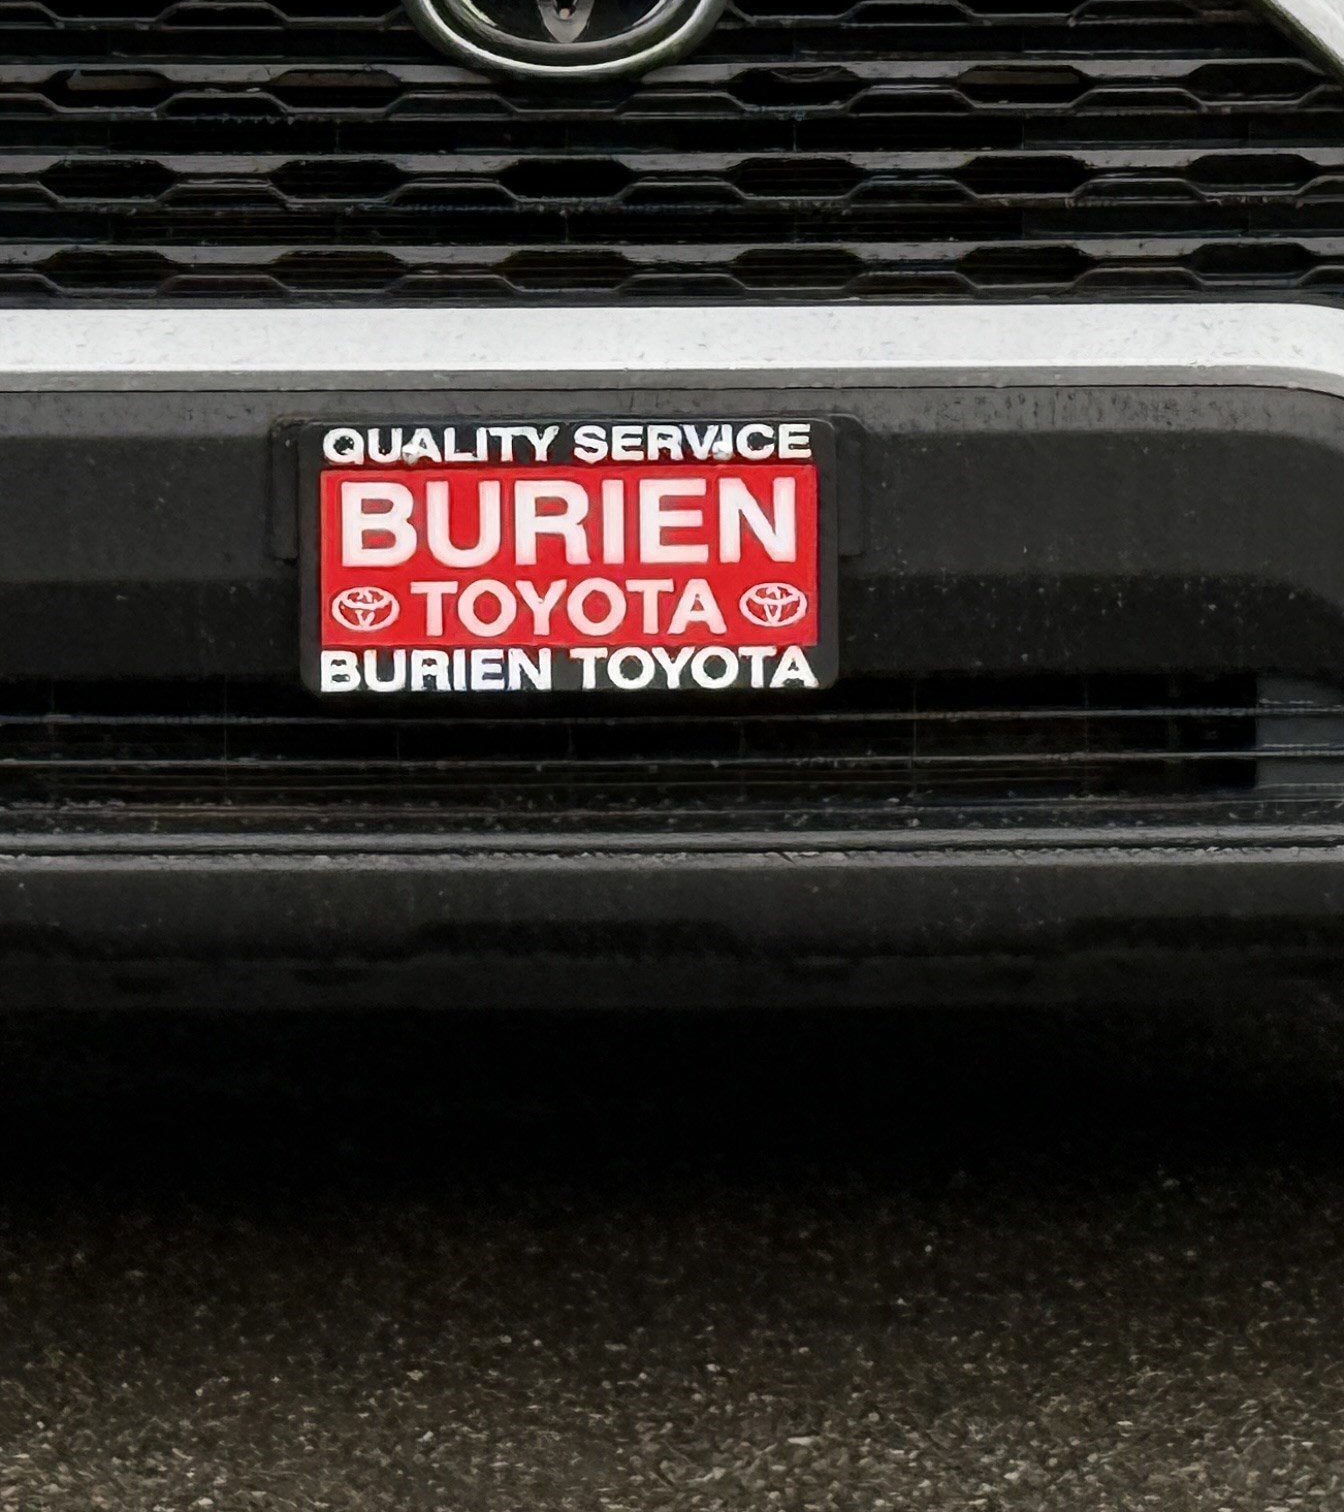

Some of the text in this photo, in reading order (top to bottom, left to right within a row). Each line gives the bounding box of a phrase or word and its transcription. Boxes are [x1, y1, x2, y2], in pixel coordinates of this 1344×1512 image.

[323, 423, 812, 464] QUALITY SERVICE
[341, 477, 797, 568] BURIEN
[410, 577, 728, 637] TOYOTA
[320, 645, 820, 692] BURIEN TOYOTA
